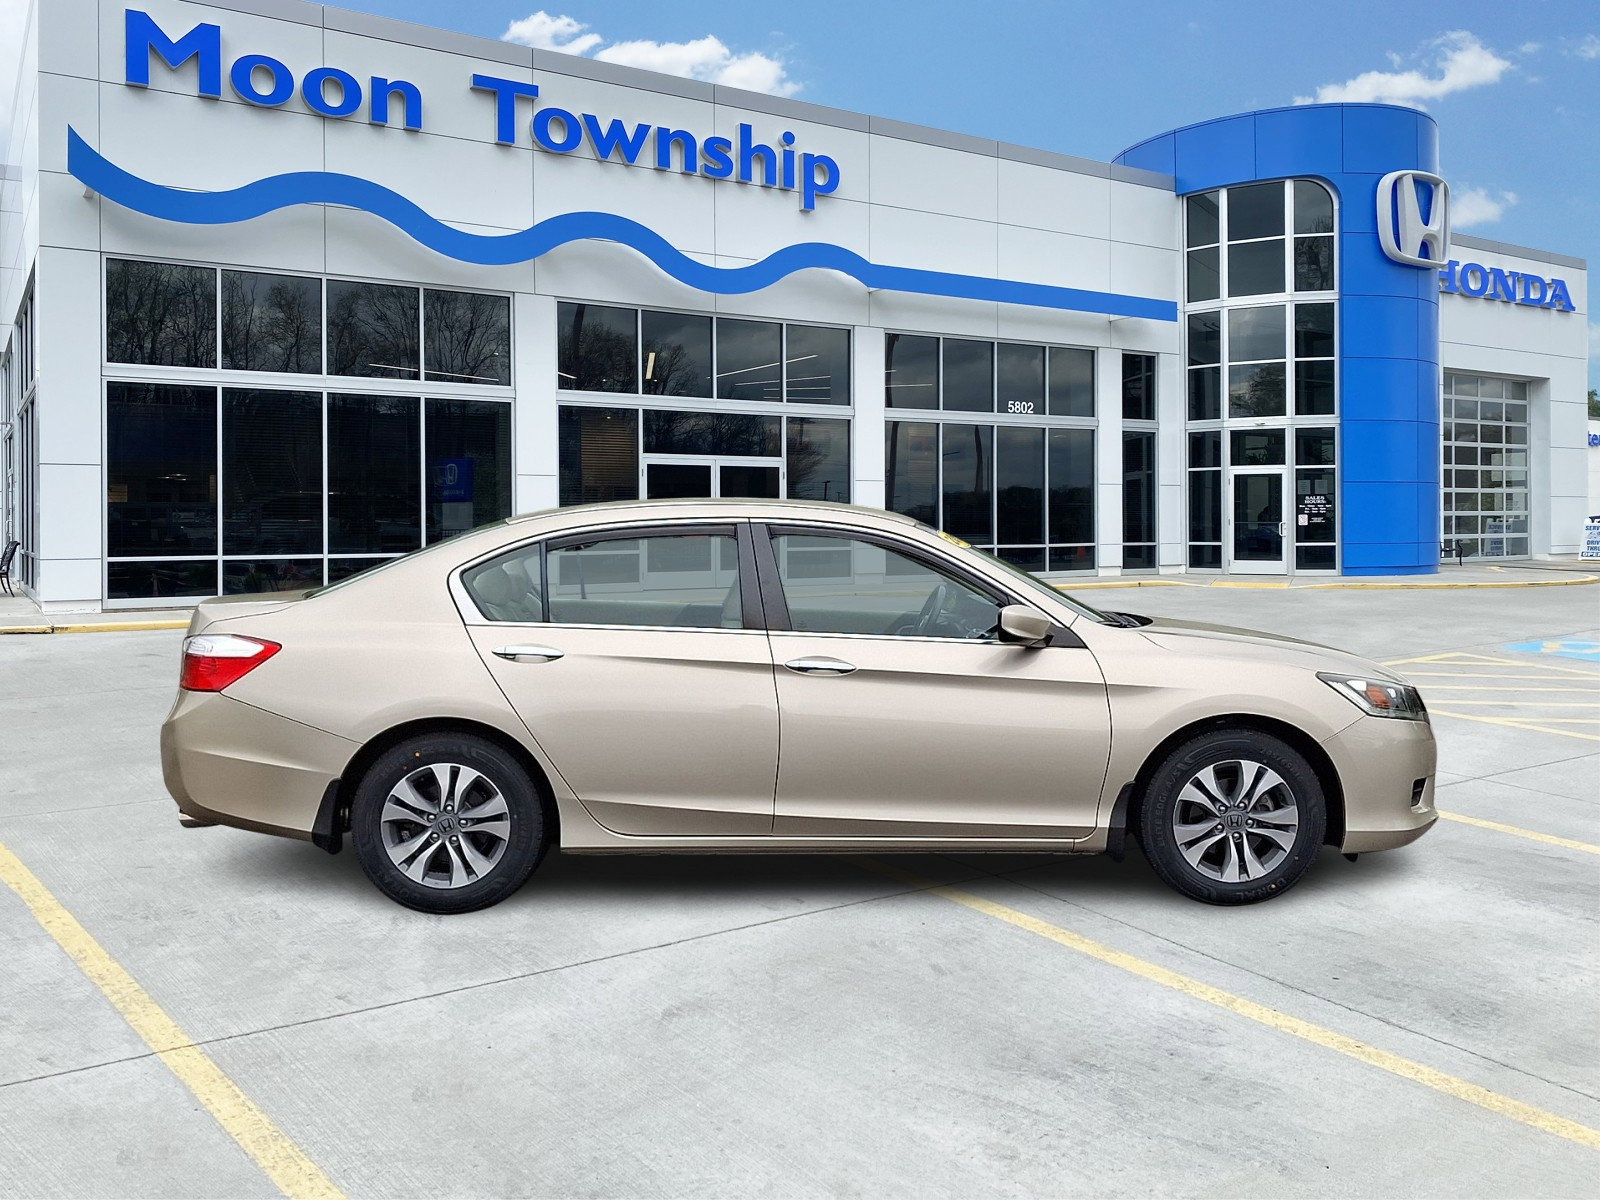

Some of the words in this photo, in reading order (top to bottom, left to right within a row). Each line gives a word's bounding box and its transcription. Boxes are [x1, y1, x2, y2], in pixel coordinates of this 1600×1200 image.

[125, 8, 422, 131] Moon
[470, 74, 841, 212] Township
[1007, 400, 1034, 414] 5802
